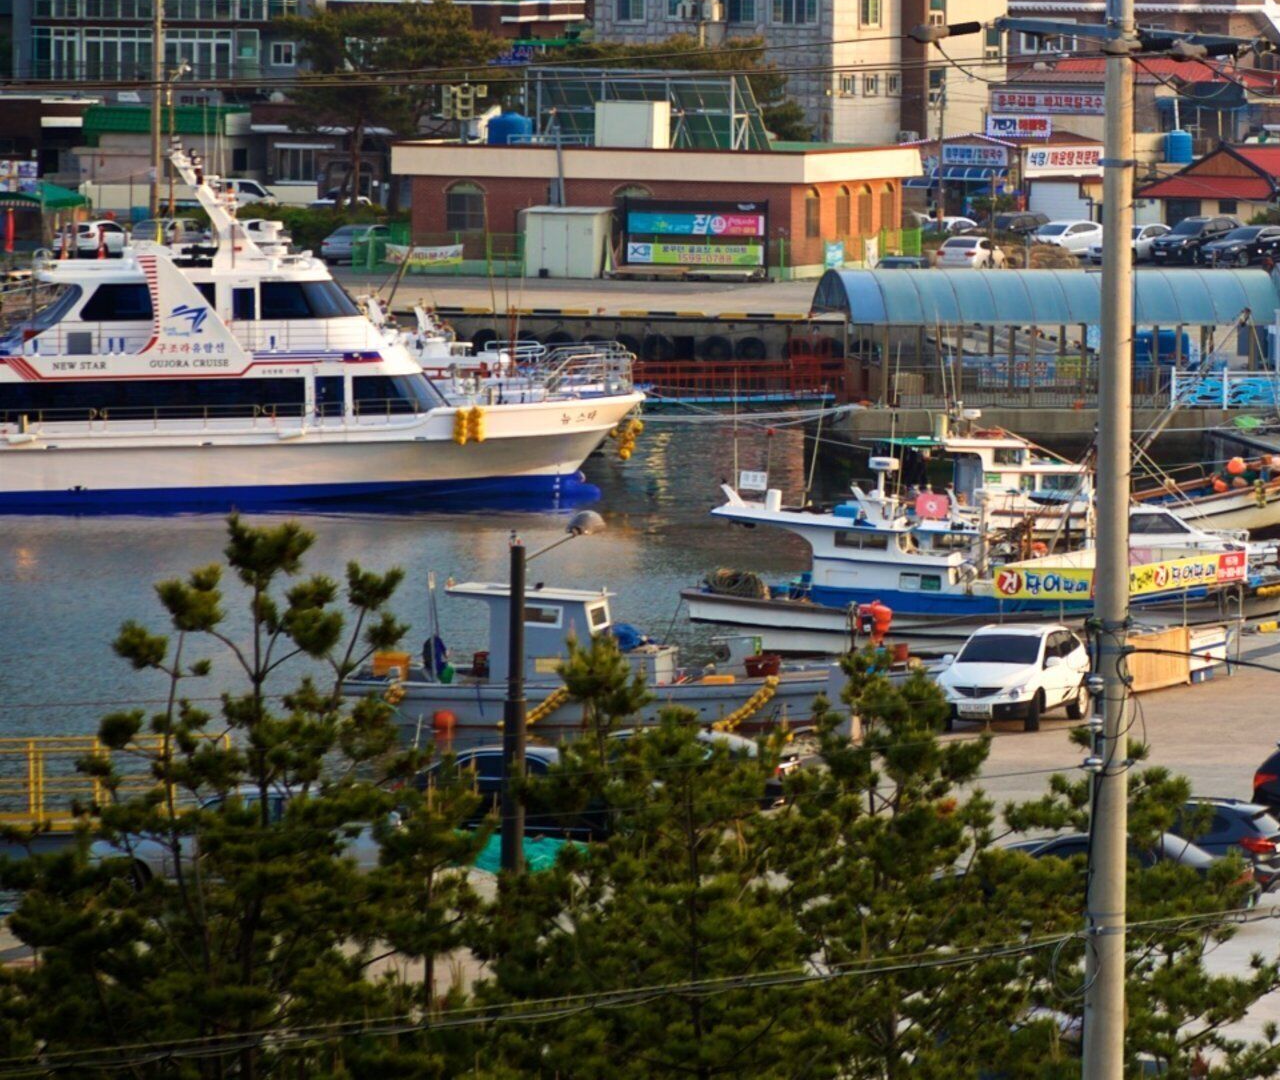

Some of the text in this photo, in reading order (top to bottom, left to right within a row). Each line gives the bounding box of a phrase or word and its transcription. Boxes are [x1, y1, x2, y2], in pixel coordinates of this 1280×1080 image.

[53, 361, 107, 370] NEW STAR
[149, 359, 229, 368] GUJORA CRUISE
